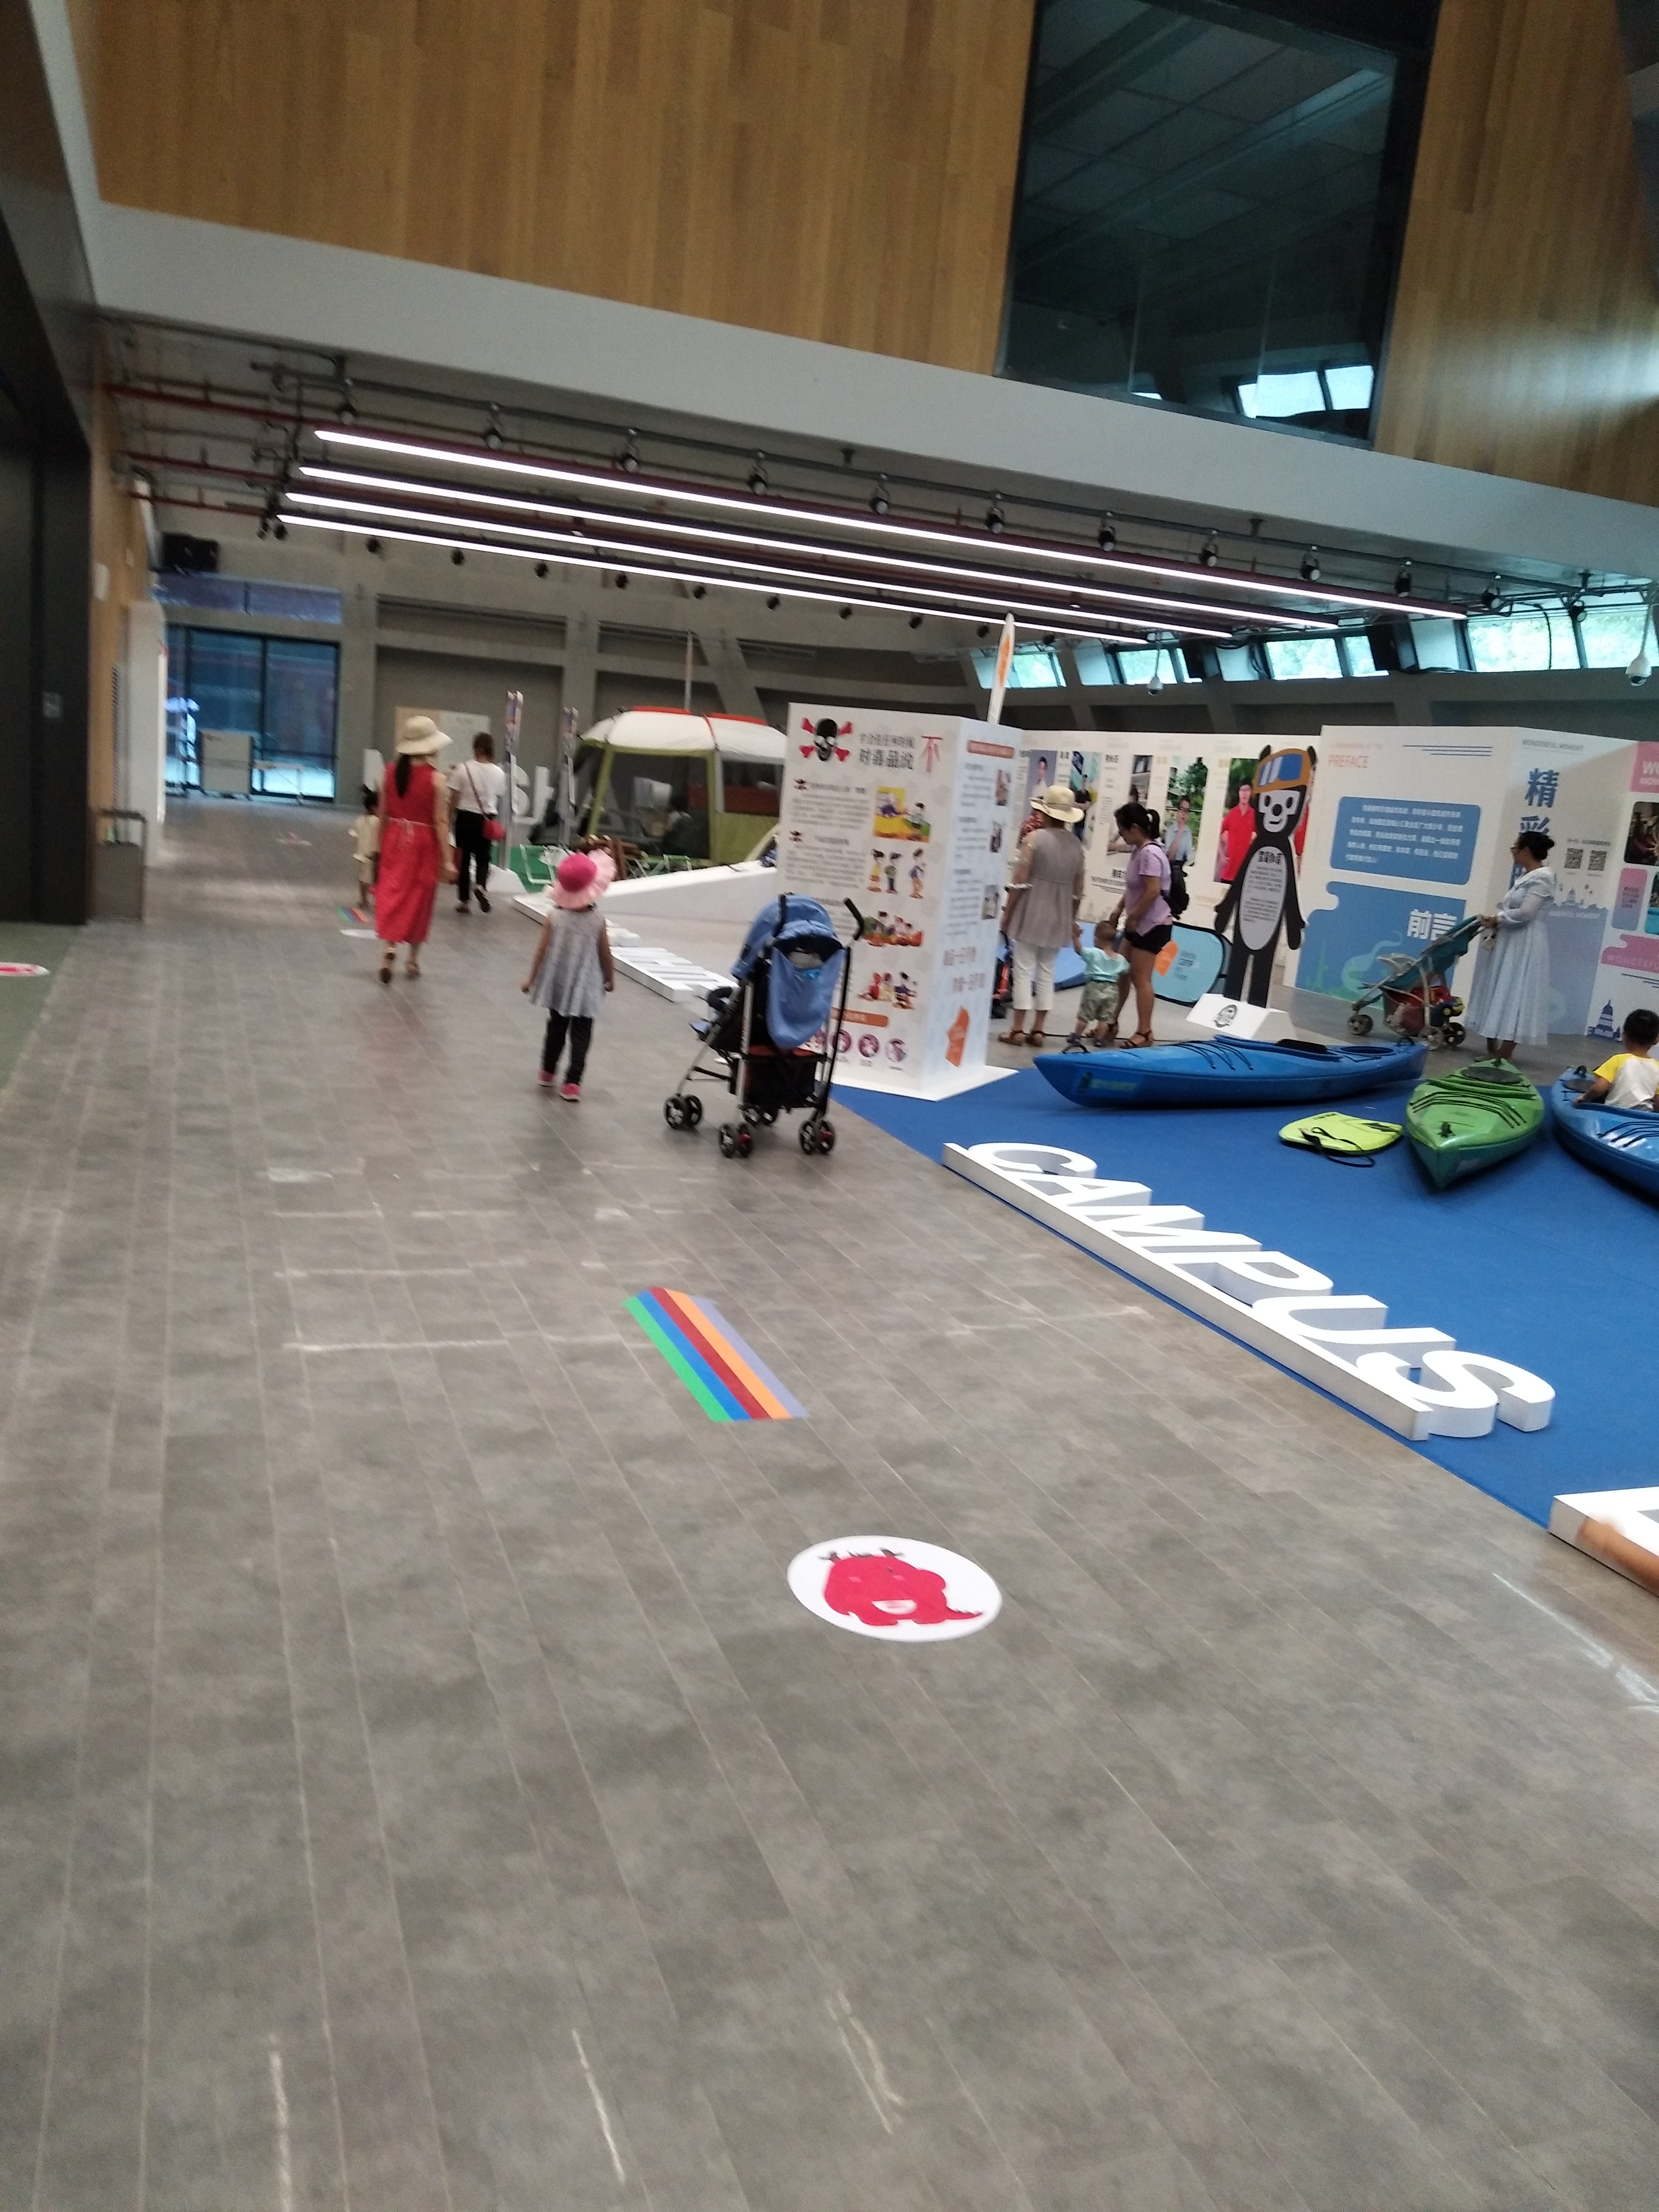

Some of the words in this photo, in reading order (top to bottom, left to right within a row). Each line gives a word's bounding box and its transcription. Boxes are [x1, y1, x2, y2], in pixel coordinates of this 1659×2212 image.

[919, 735, 943, 773] 不
[1328, 755, 1370, 768] PREFACE
[1407, 908, 1457, 941] 前言
[953, 1142, 1556, 1438] CAMPUS
